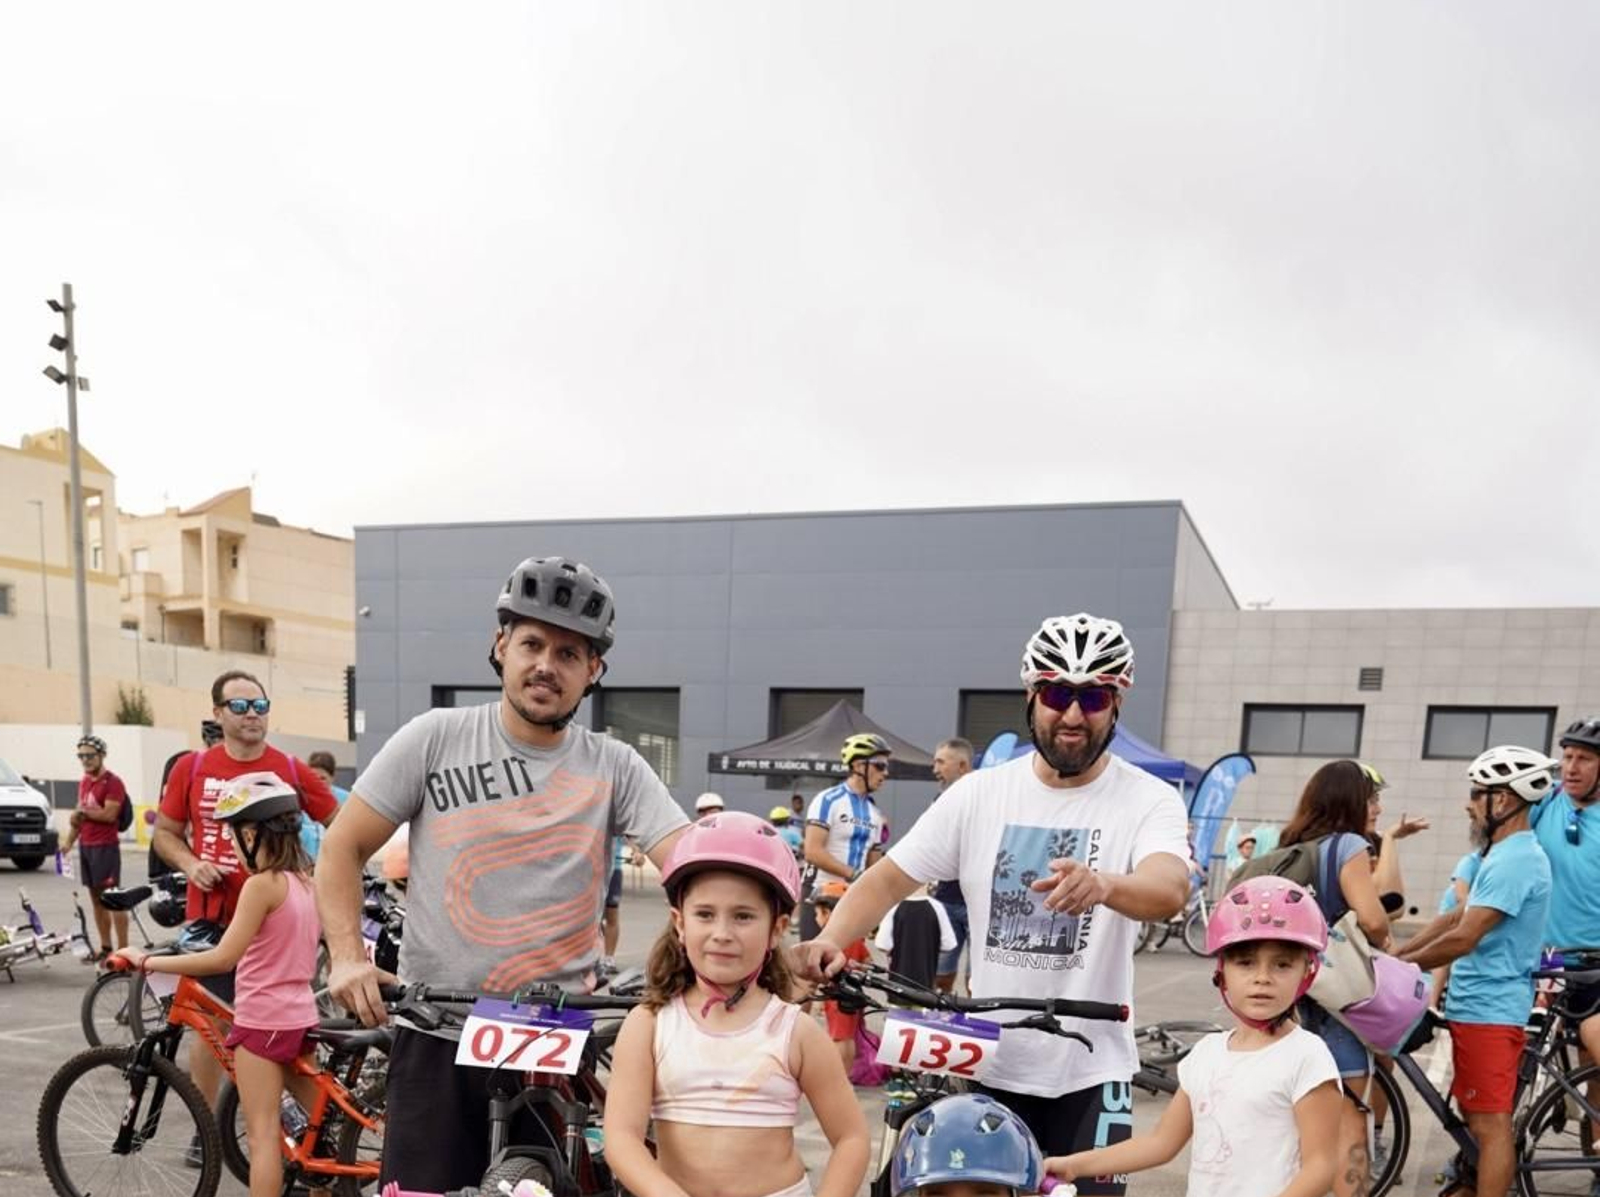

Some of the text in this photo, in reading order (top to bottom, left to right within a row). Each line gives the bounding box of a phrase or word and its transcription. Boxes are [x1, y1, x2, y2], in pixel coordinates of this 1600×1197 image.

[426, 756, 534, 812] GIVE IT
[983, 948, 1085, 971] MONICA
[471, 1024, 572, 1068] 072
[898, 1028, 983, 1076] 132
